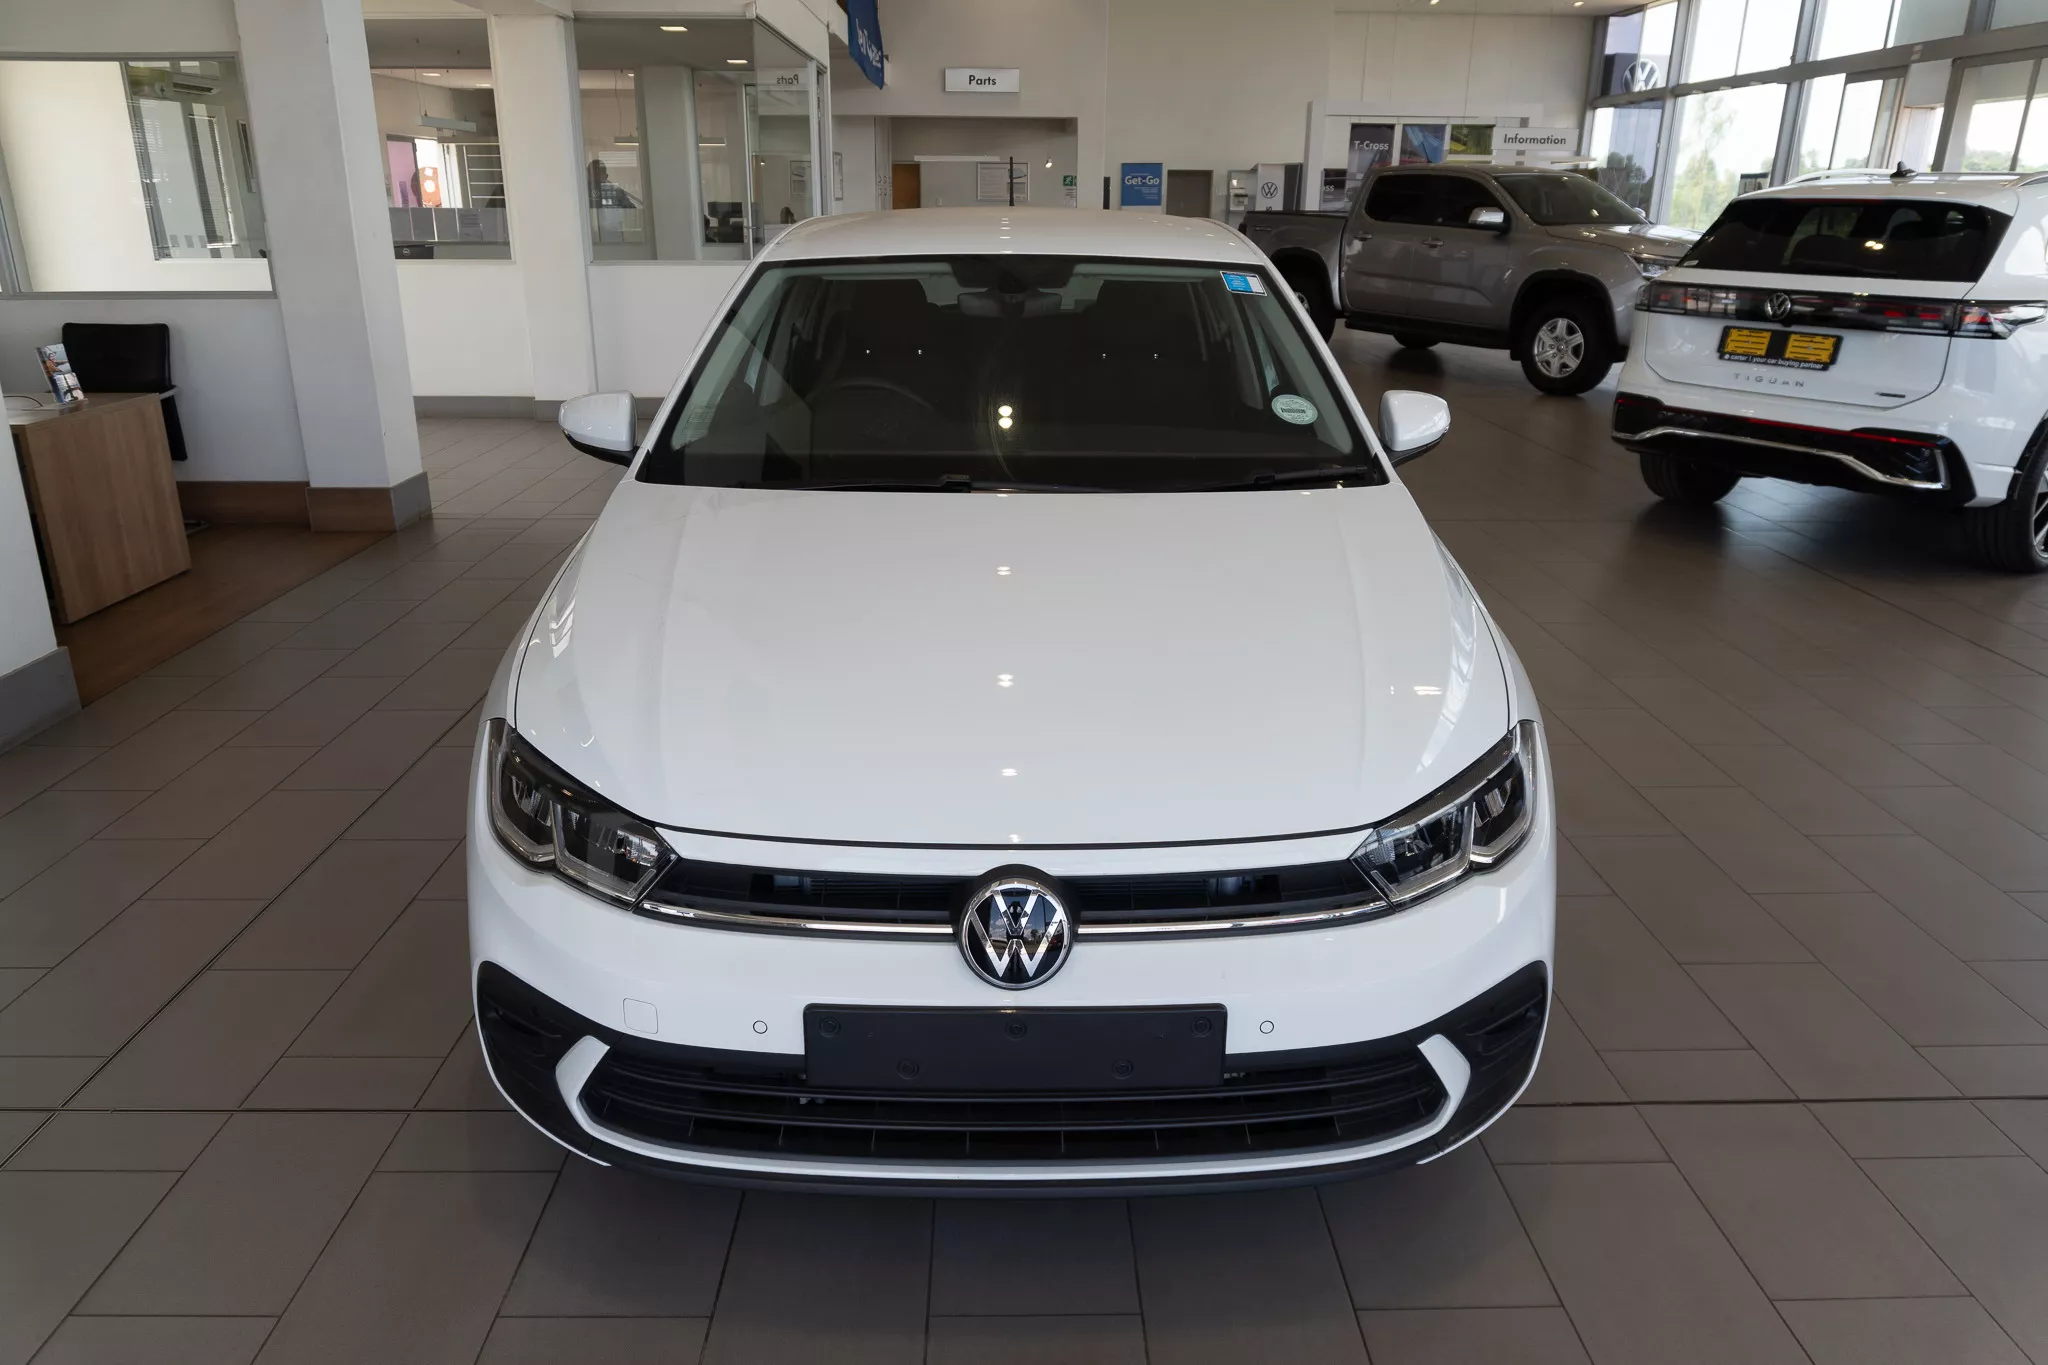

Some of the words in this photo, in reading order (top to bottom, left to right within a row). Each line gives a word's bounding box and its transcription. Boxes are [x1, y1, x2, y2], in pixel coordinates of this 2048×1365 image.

[968, 75, 997, 86] Parts
[1503, 133, 1567, 145] Information
[1354, 140, 1389, 150] T-Cross
[1125, 176, 1160, 185] Get-Go
[1778, 359, 1799, 368] buying
[1800, 361, 1824, 370] partner
[1733, 373, 1805, 387] TIGUAN
